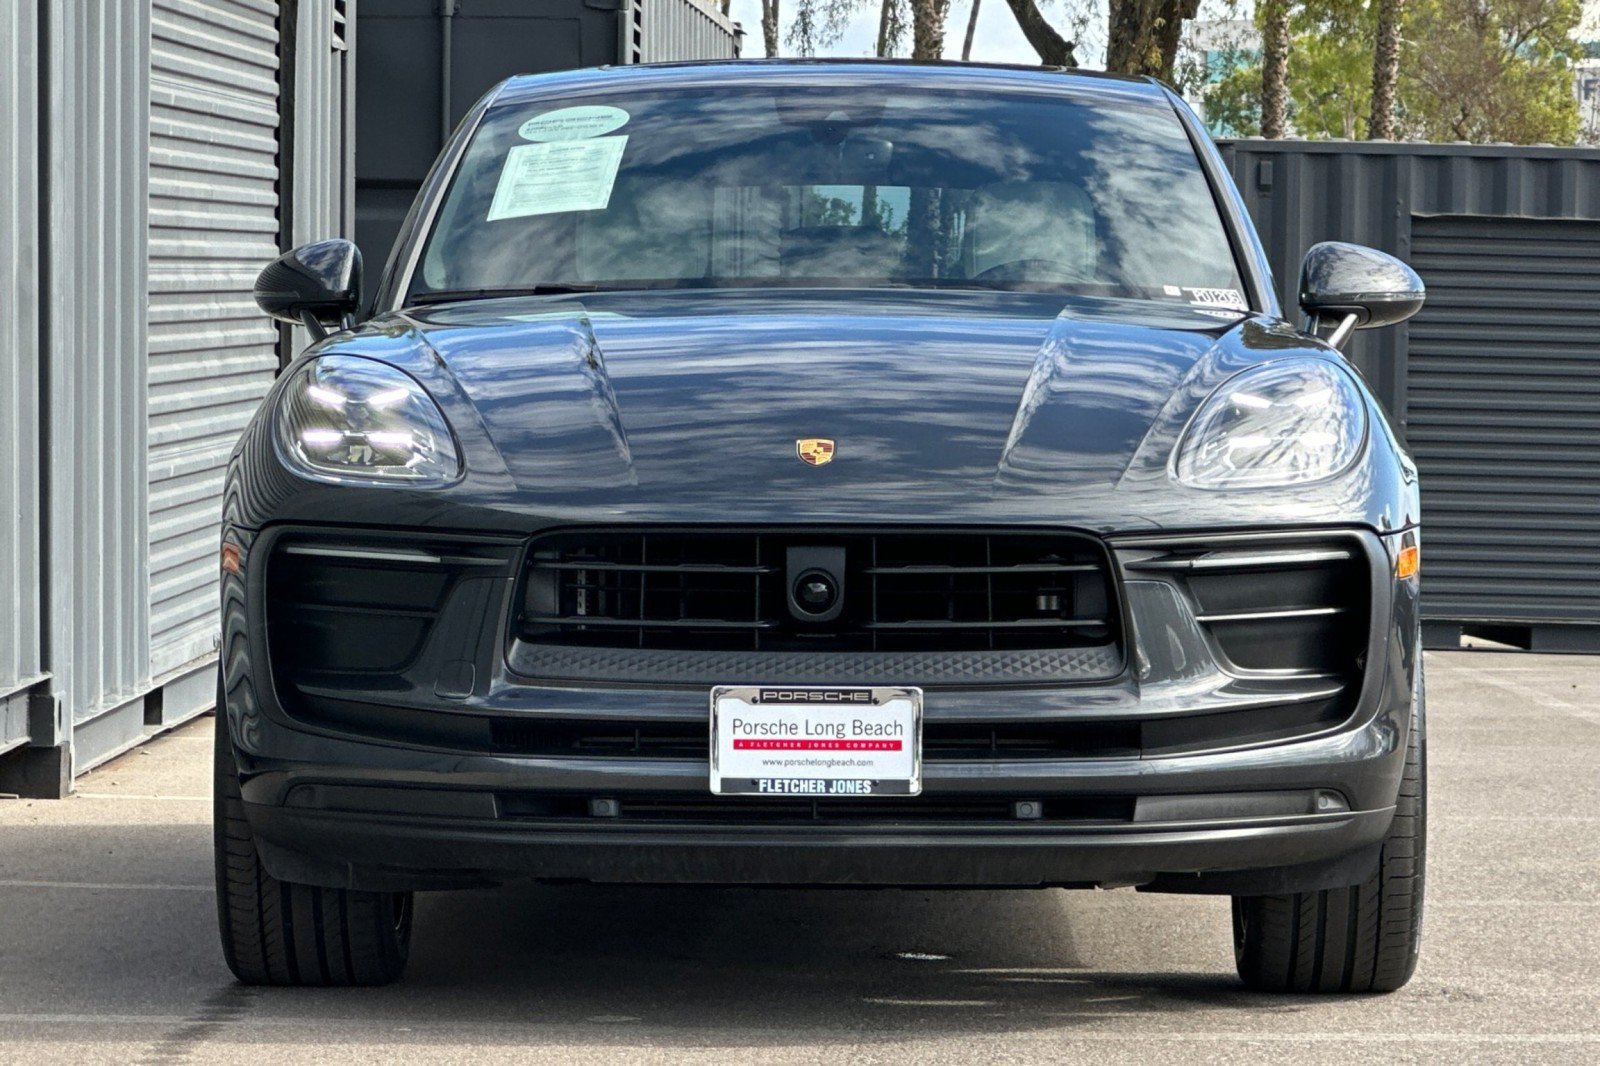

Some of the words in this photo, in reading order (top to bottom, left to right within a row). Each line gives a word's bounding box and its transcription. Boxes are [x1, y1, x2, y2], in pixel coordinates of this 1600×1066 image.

[762, 691, 869, 701] PORSCHE
[732, 718, 798, 735] Porsche
[805, 719, 846, 738] Long
[852, 720, 903, 736] Beach
[762, 758, 874, 768] www.porschelongbeach.com
[759, 779, 827, 793] FLETCHER
[829, 779, 872, 793] JONES
